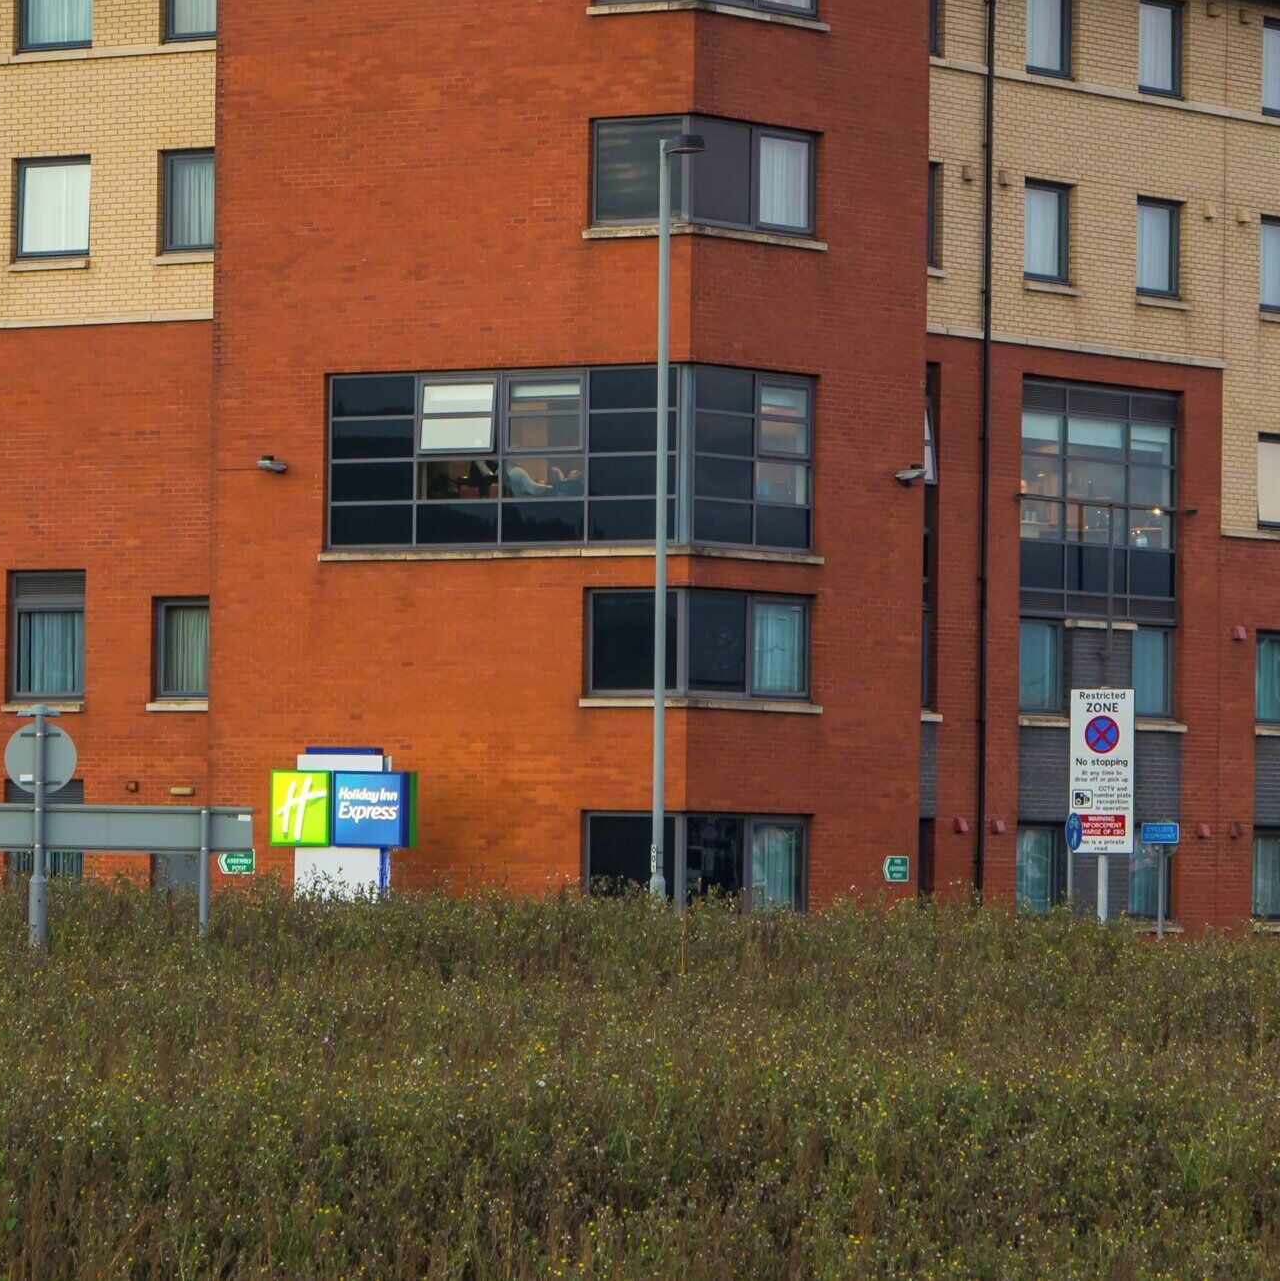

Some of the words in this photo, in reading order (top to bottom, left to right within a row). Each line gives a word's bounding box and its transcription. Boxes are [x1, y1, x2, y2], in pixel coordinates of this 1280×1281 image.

[1079, 691, 1126, 700] Restricted
[1086, 702, 1119, 713] ZONE
[1075, 758, 1088, 766] No
[1091, 758, 1129, 767] stopping
[338, 786, 379, 804] Holiday
[380, 787, 398, 801] Inn
[337, 801, 398, 824] Express
